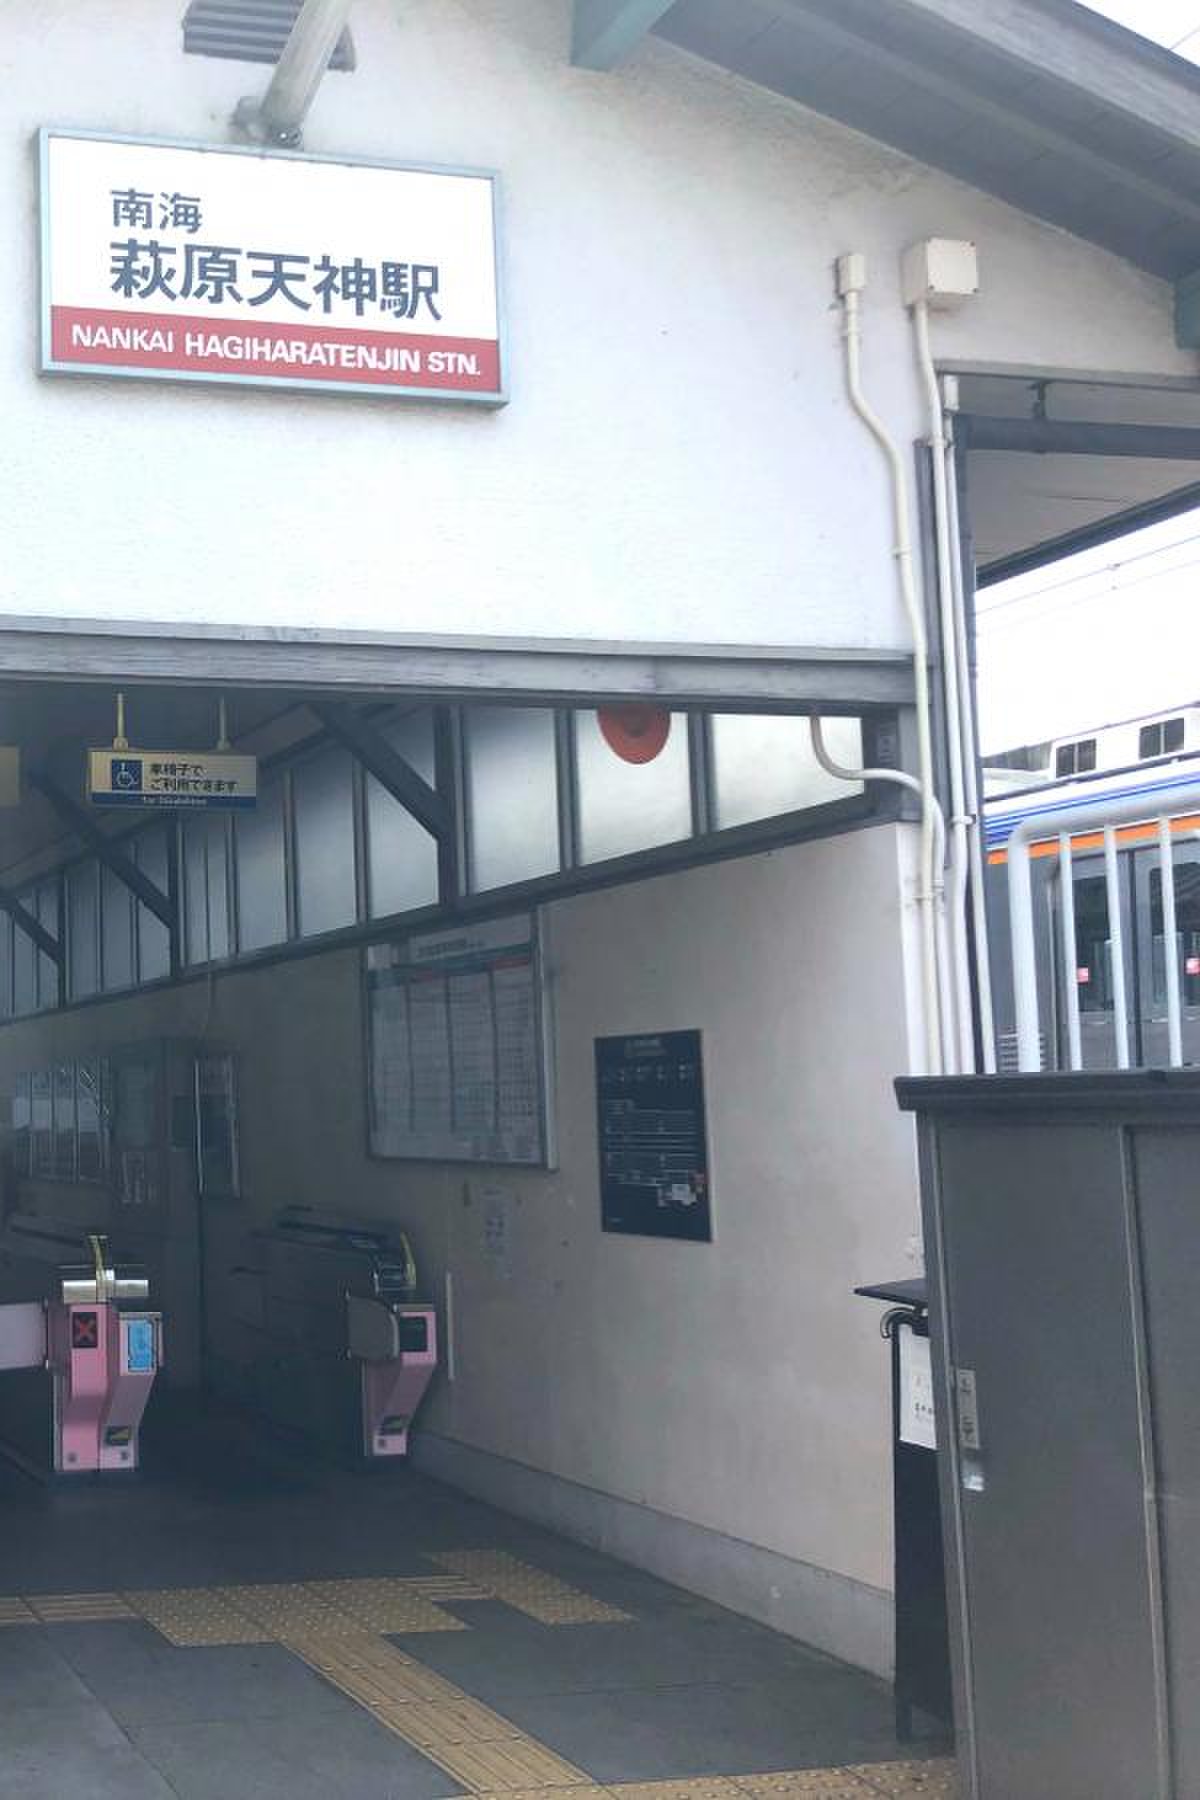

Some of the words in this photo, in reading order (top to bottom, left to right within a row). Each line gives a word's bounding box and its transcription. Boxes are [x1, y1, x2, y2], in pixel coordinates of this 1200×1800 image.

[110, 187, 203, 234] 南海
[110, 237, 443, 321] 萩原天神駅
[71, 323, 174, 355] NANKAI
[184, 332, 421, 373] HAGIHARATENJIN
[426, 350, 482, 377] STN.
